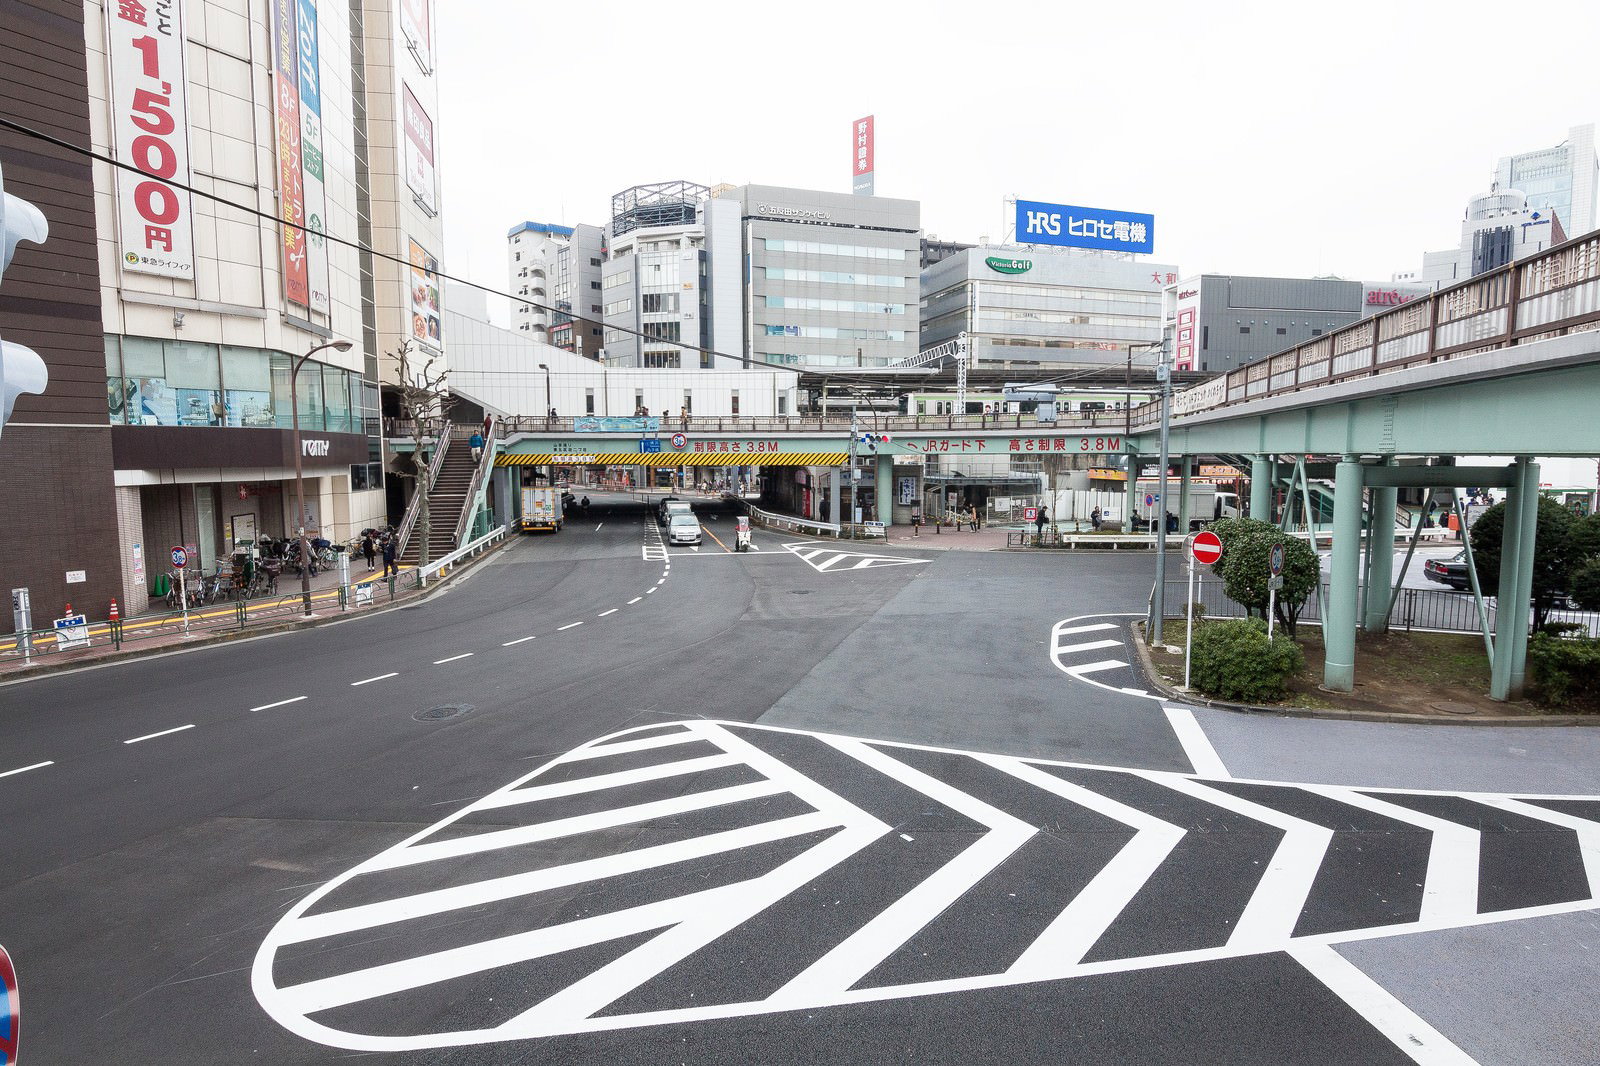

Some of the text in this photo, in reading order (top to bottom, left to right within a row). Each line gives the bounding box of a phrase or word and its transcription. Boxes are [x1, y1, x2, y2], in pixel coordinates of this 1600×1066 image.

[306, 113, 318, 140] 5F
[1026, 211, 1147, 243] HRS ヒロセ電機
[1012, 260, 1031, 269] Golf
[694, 441, 779, 452] 制限高さ 3.8M
[922, 438, 1120, 451] JRガード下 高さ制限 3.8M
